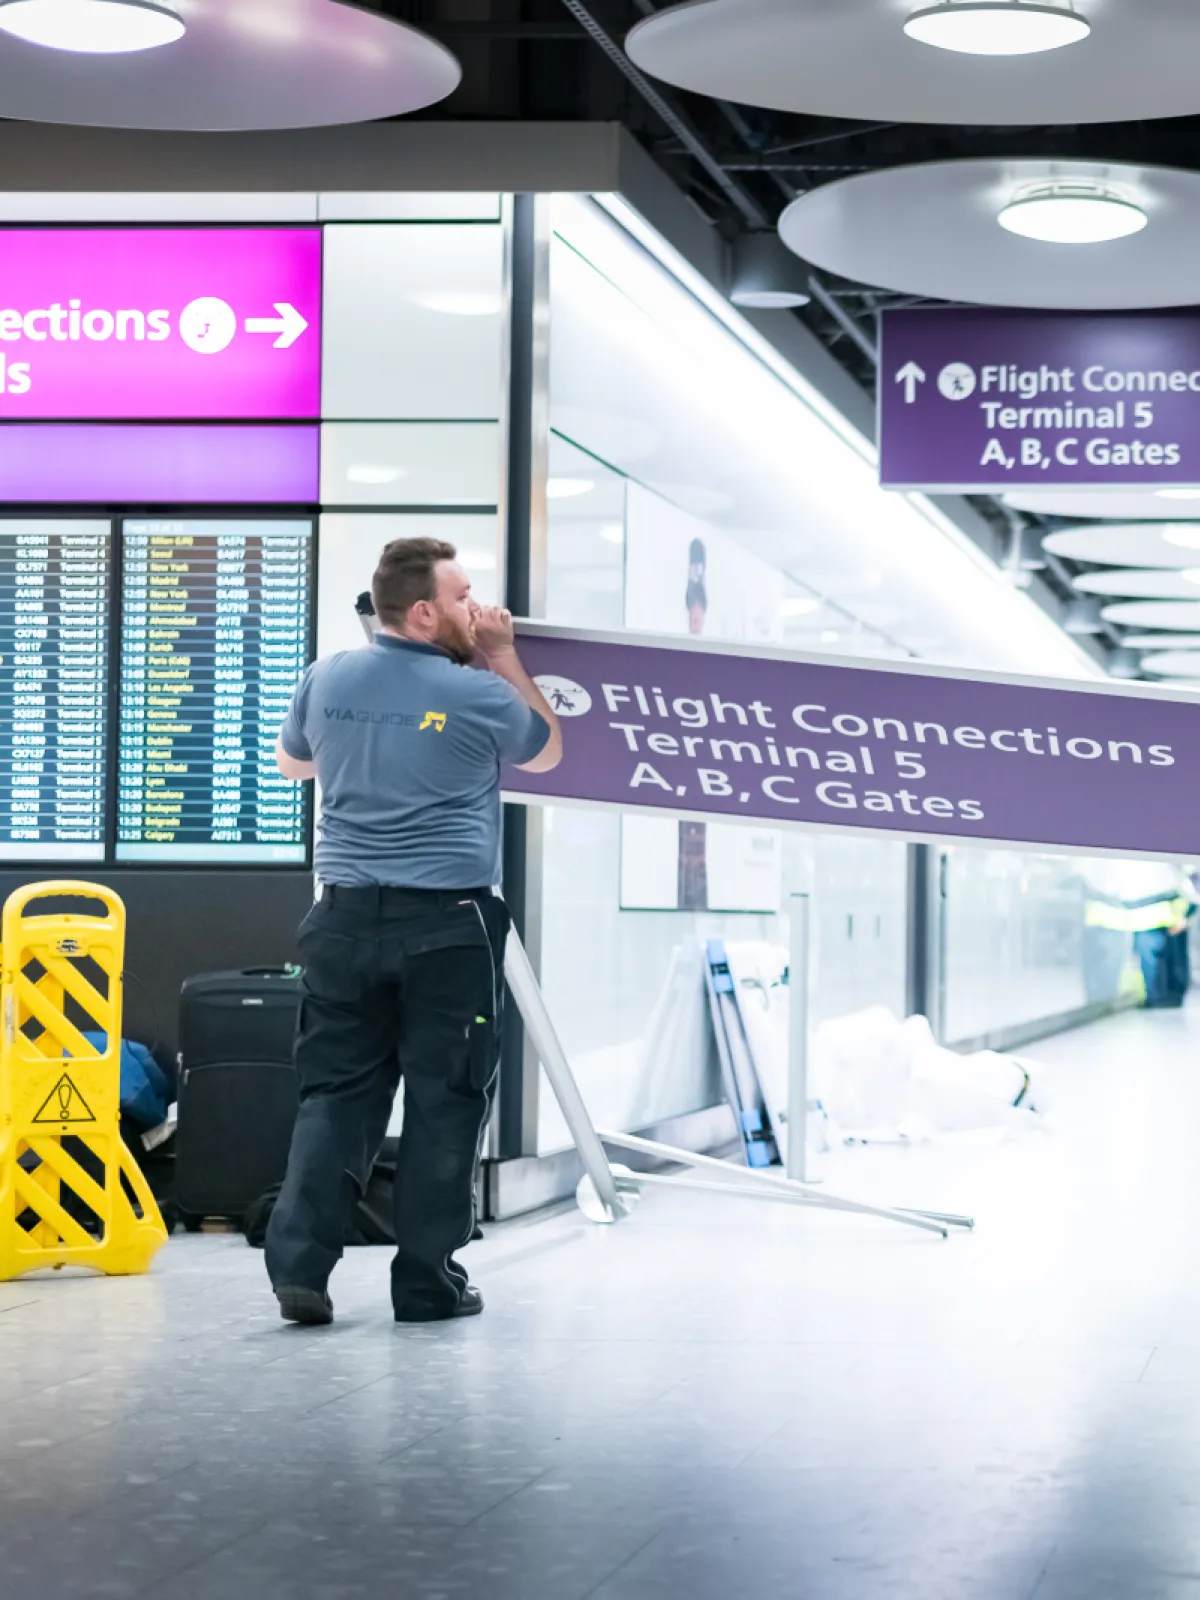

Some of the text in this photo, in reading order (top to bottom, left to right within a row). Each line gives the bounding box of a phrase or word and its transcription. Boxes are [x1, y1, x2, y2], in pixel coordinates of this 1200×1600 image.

[981, 365, 1075, 399] Flight
[980, 401, 1153, 429] Terminal 5
[1085, 438, 1181, 467] Gates
[324, 708, 415, 726] VIAGUIDE
[601, 683, 1175, 767] Flight Connections
[609, 722, 927, 779] Terminal 5
[814, 781, 985, 820] Gates
